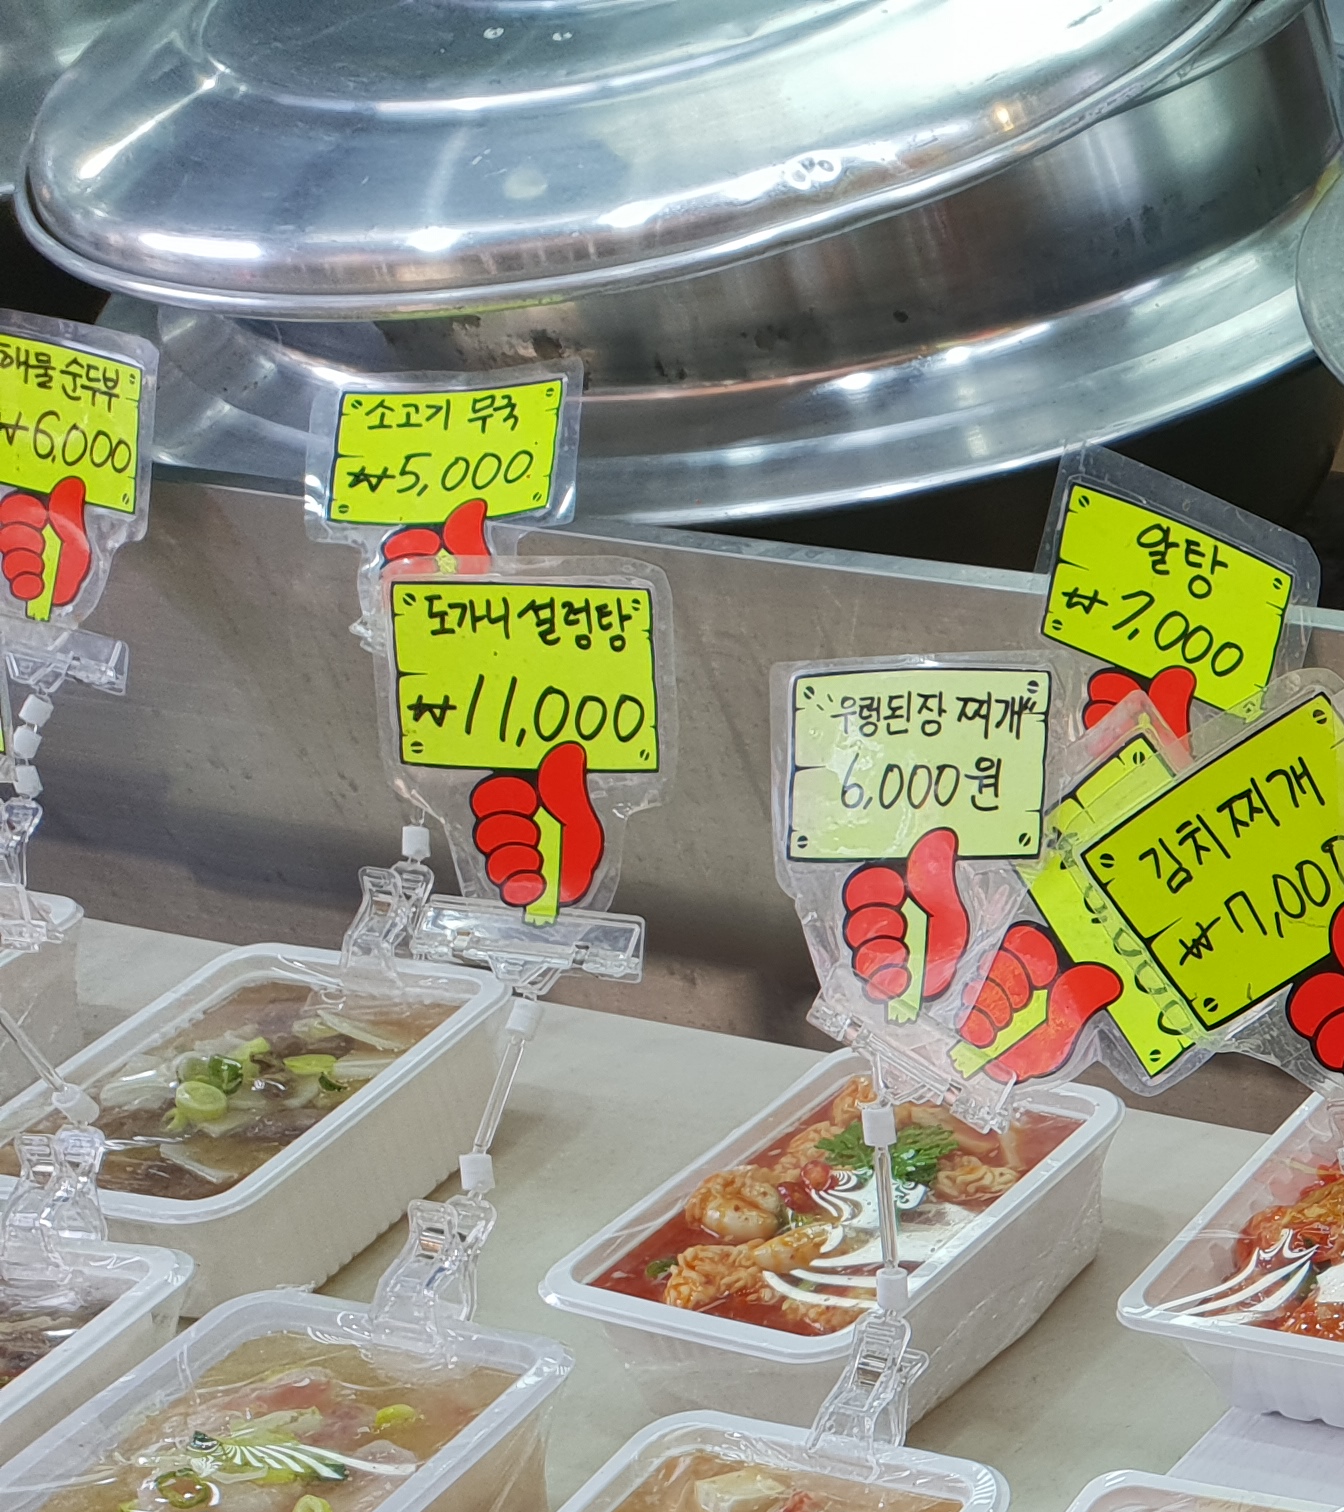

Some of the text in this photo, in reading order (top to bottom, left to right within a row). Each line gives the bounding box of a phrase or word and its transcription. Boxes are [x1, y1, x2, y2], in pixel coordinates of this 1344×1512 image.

[0, 344, 120, 413] 해물 순두부
[365, 394, 520, 433] 소고기 무국
[1136, 523, 1229, 600] 알탕
